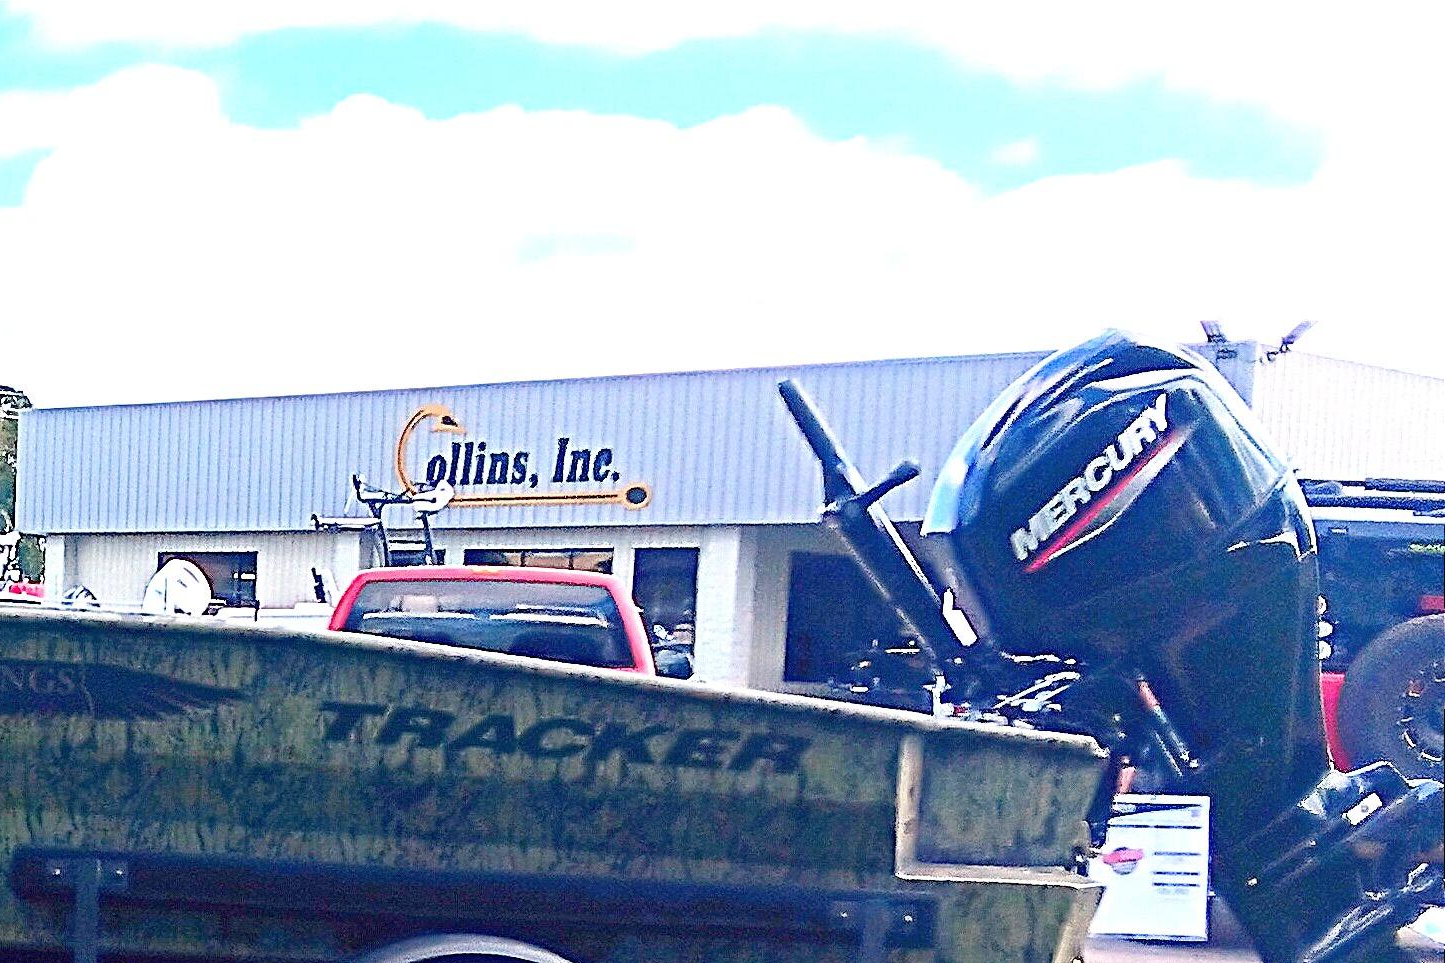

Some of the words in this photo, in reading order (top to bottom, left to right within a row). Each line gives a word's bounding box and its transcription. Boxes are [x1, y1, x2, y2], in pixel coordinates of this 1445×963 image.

[552, 437, 621, 483] Inc.
[1009, 393, 1170, 561] MERCURY
[320, 700, 815, 773] TRACKER
